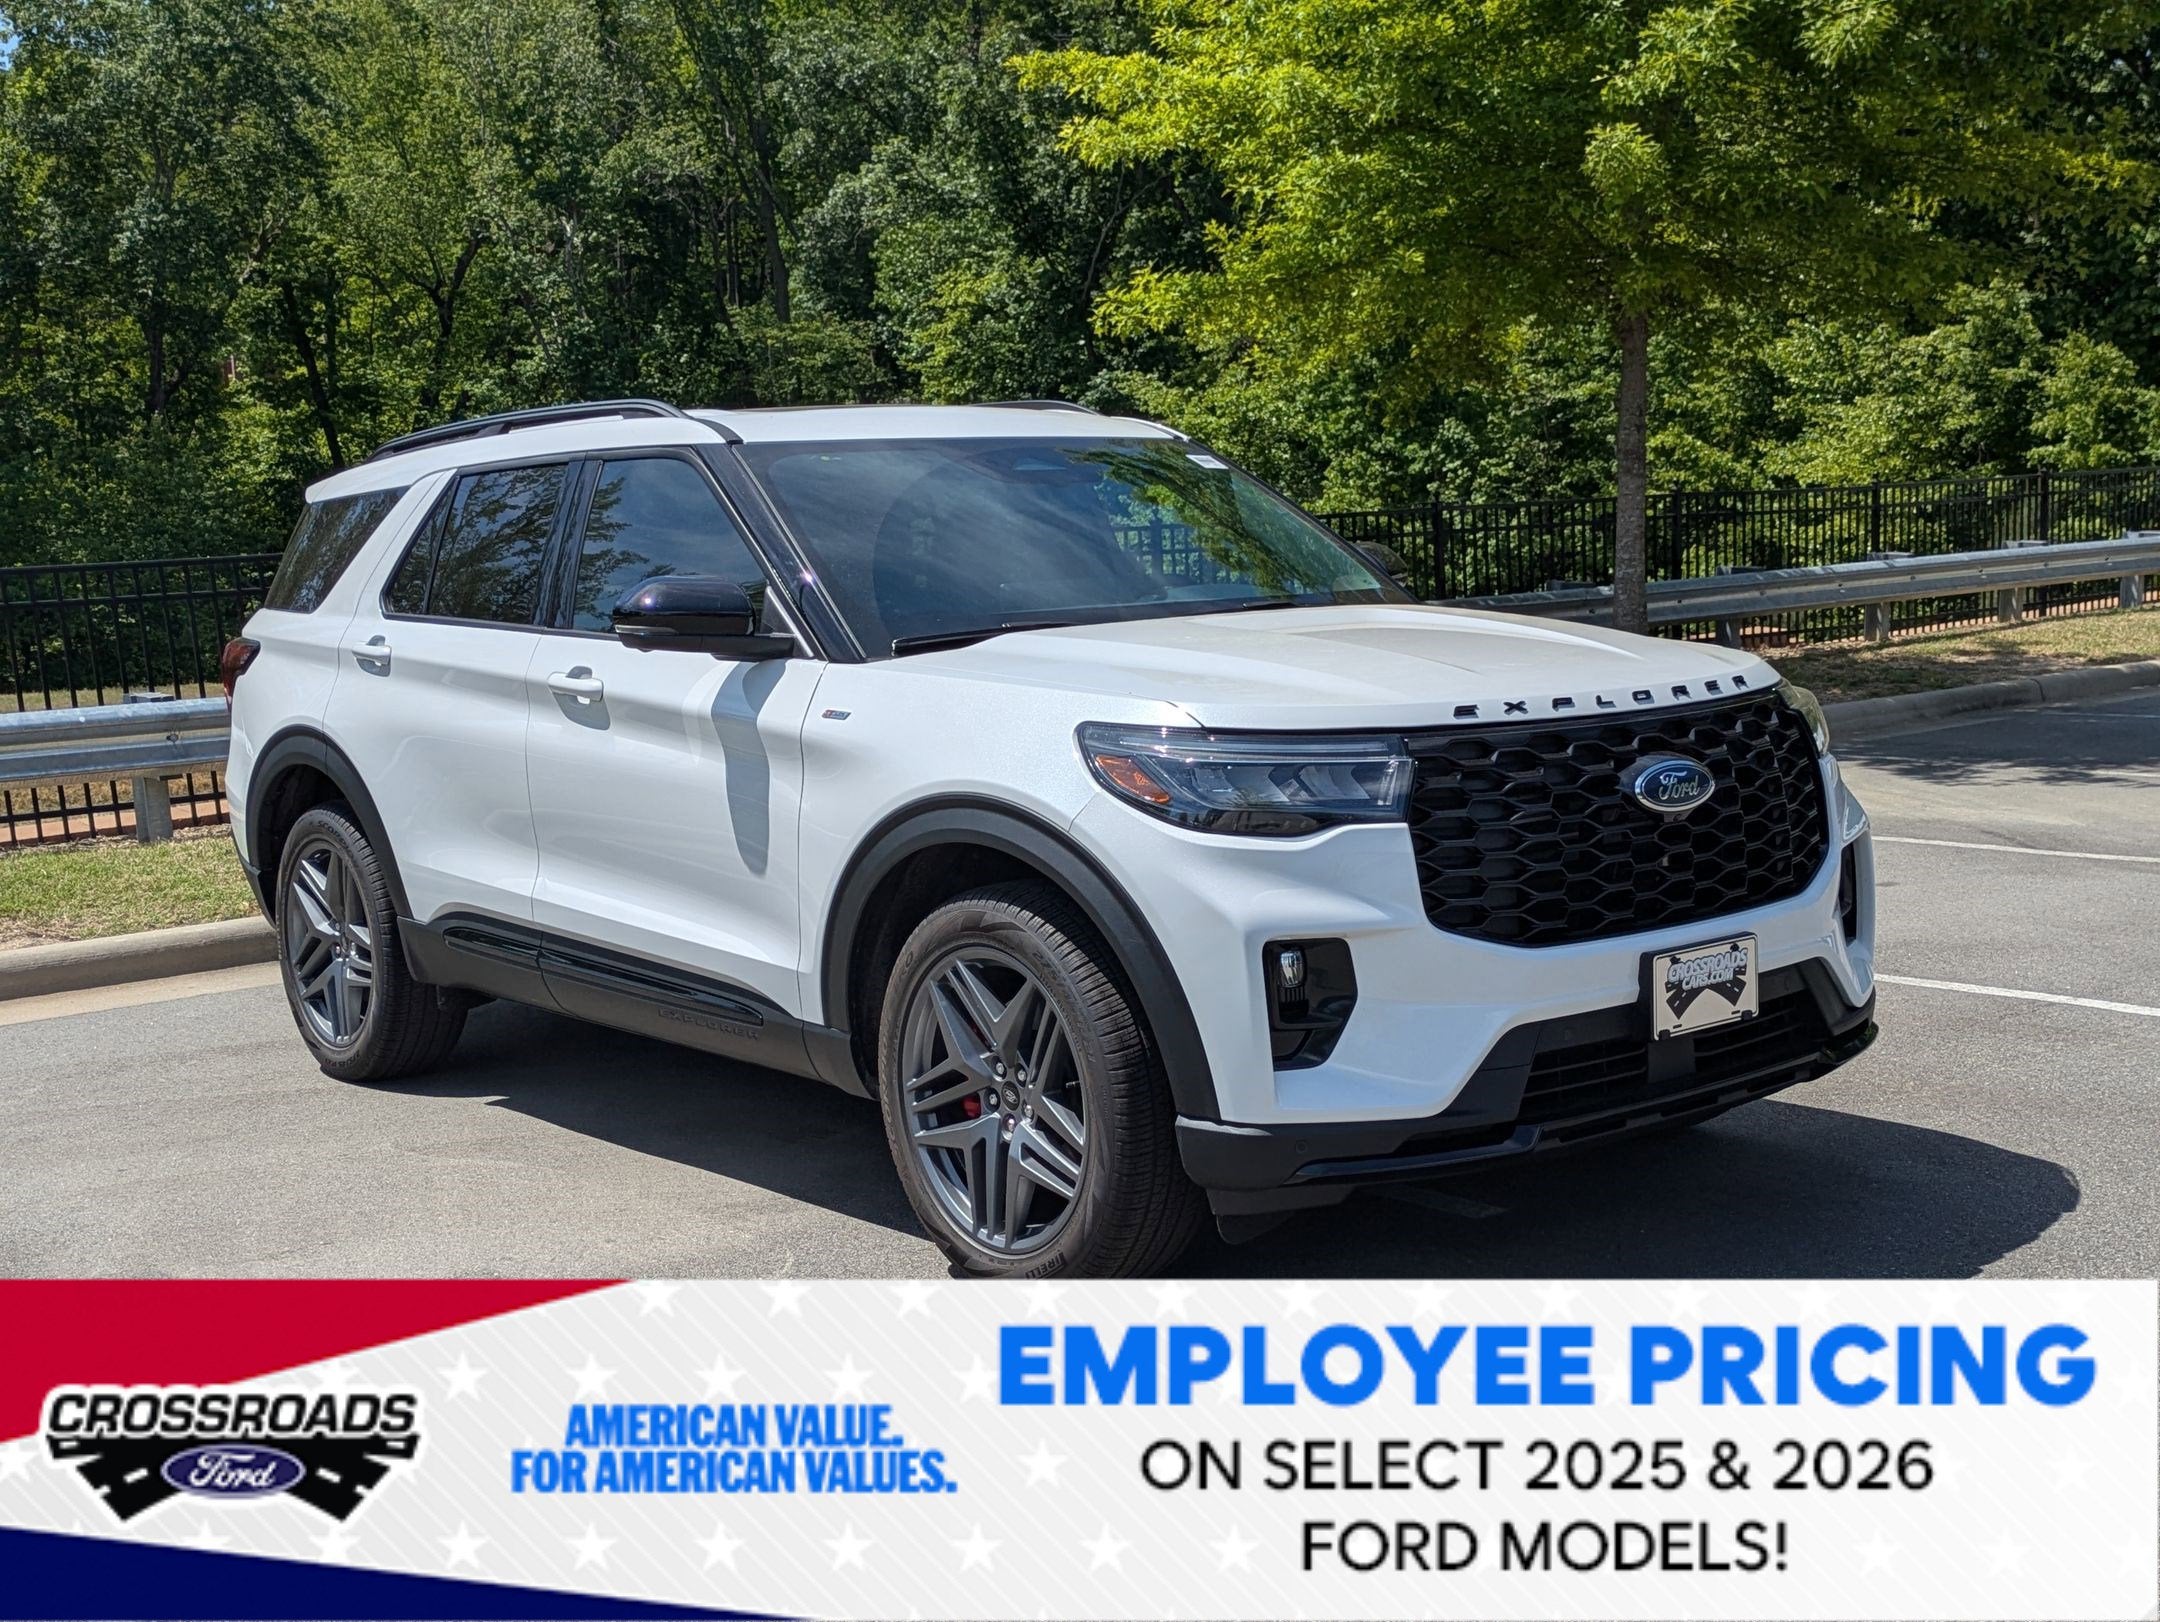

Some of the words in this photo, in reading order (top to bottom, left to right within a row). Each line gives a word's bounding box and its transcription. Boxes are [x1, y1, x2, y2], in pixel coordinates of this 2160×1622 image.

[1453, 674, 1749, 720] EXPLORER
[1658, 771, 1700, 800] Ford
[1668, 947, 1748, 983] CROSSROADS
[1681, 967, 1734, 991] CARS.COM
[657, 1008, 759, 1040] EXPLORER
[1025, 1251, 1068, 1279] PIRELLI
